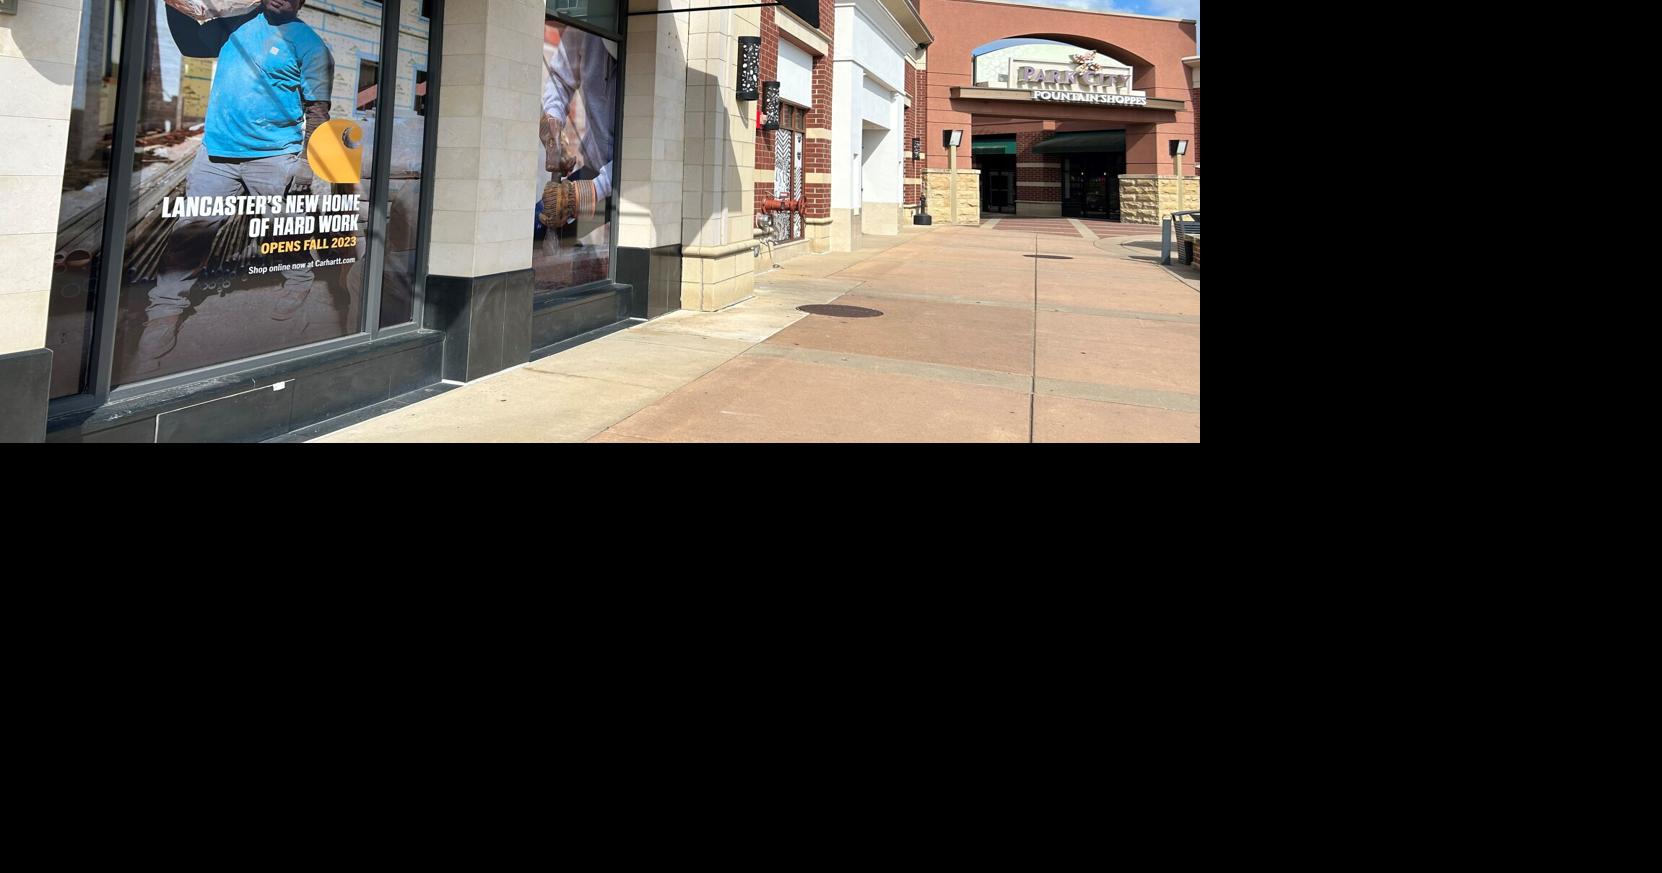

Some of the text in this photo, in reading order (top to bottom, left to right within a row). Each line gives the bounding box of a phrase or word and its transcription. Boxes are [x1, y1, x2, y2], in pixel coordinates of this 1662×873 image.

[1018, 66, 1131, 87] PARK CITY
[1099, 94, 1147, 106] SHOPPES
[162, 194, 360, 218] LANCASTER'S NEW HOME
[248, 214, 359, 238] OF HARD WORK
[260, 237, 356, 254] OPENS FALL 2023
[248, 257, 356, 275] Shop online now at Carhartt.com
